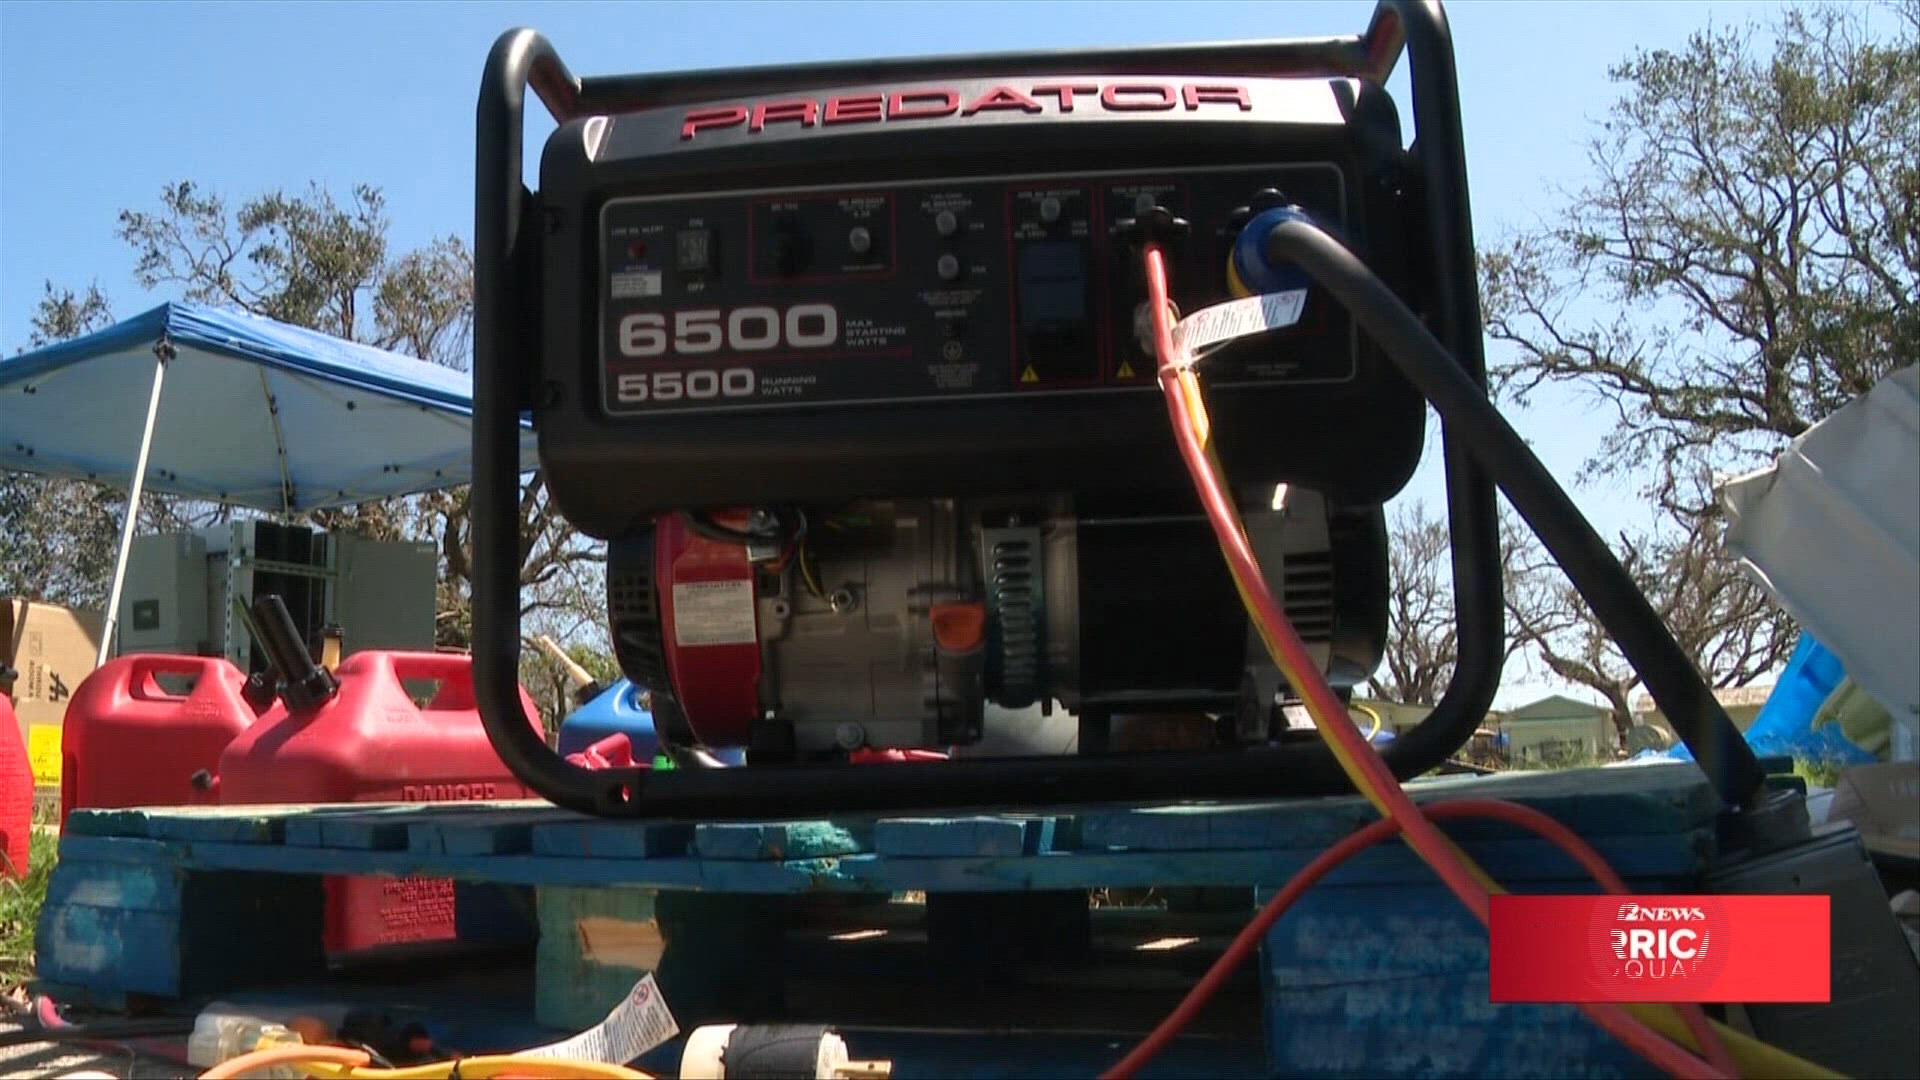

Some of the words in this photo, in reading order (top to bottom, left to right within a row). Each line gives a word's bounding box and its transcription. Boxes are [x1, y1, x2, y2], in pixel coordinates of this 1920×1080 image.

[680, 83, 1252, 140] PREDATOR
[619, 303, 838, 357] 6500
[846, 327, 906, 337] STARTING
[846, 336, 887, 346] WATTS
[617, 368, 755, 403] 5500
[761, 375, 817, 385] RUNNING
